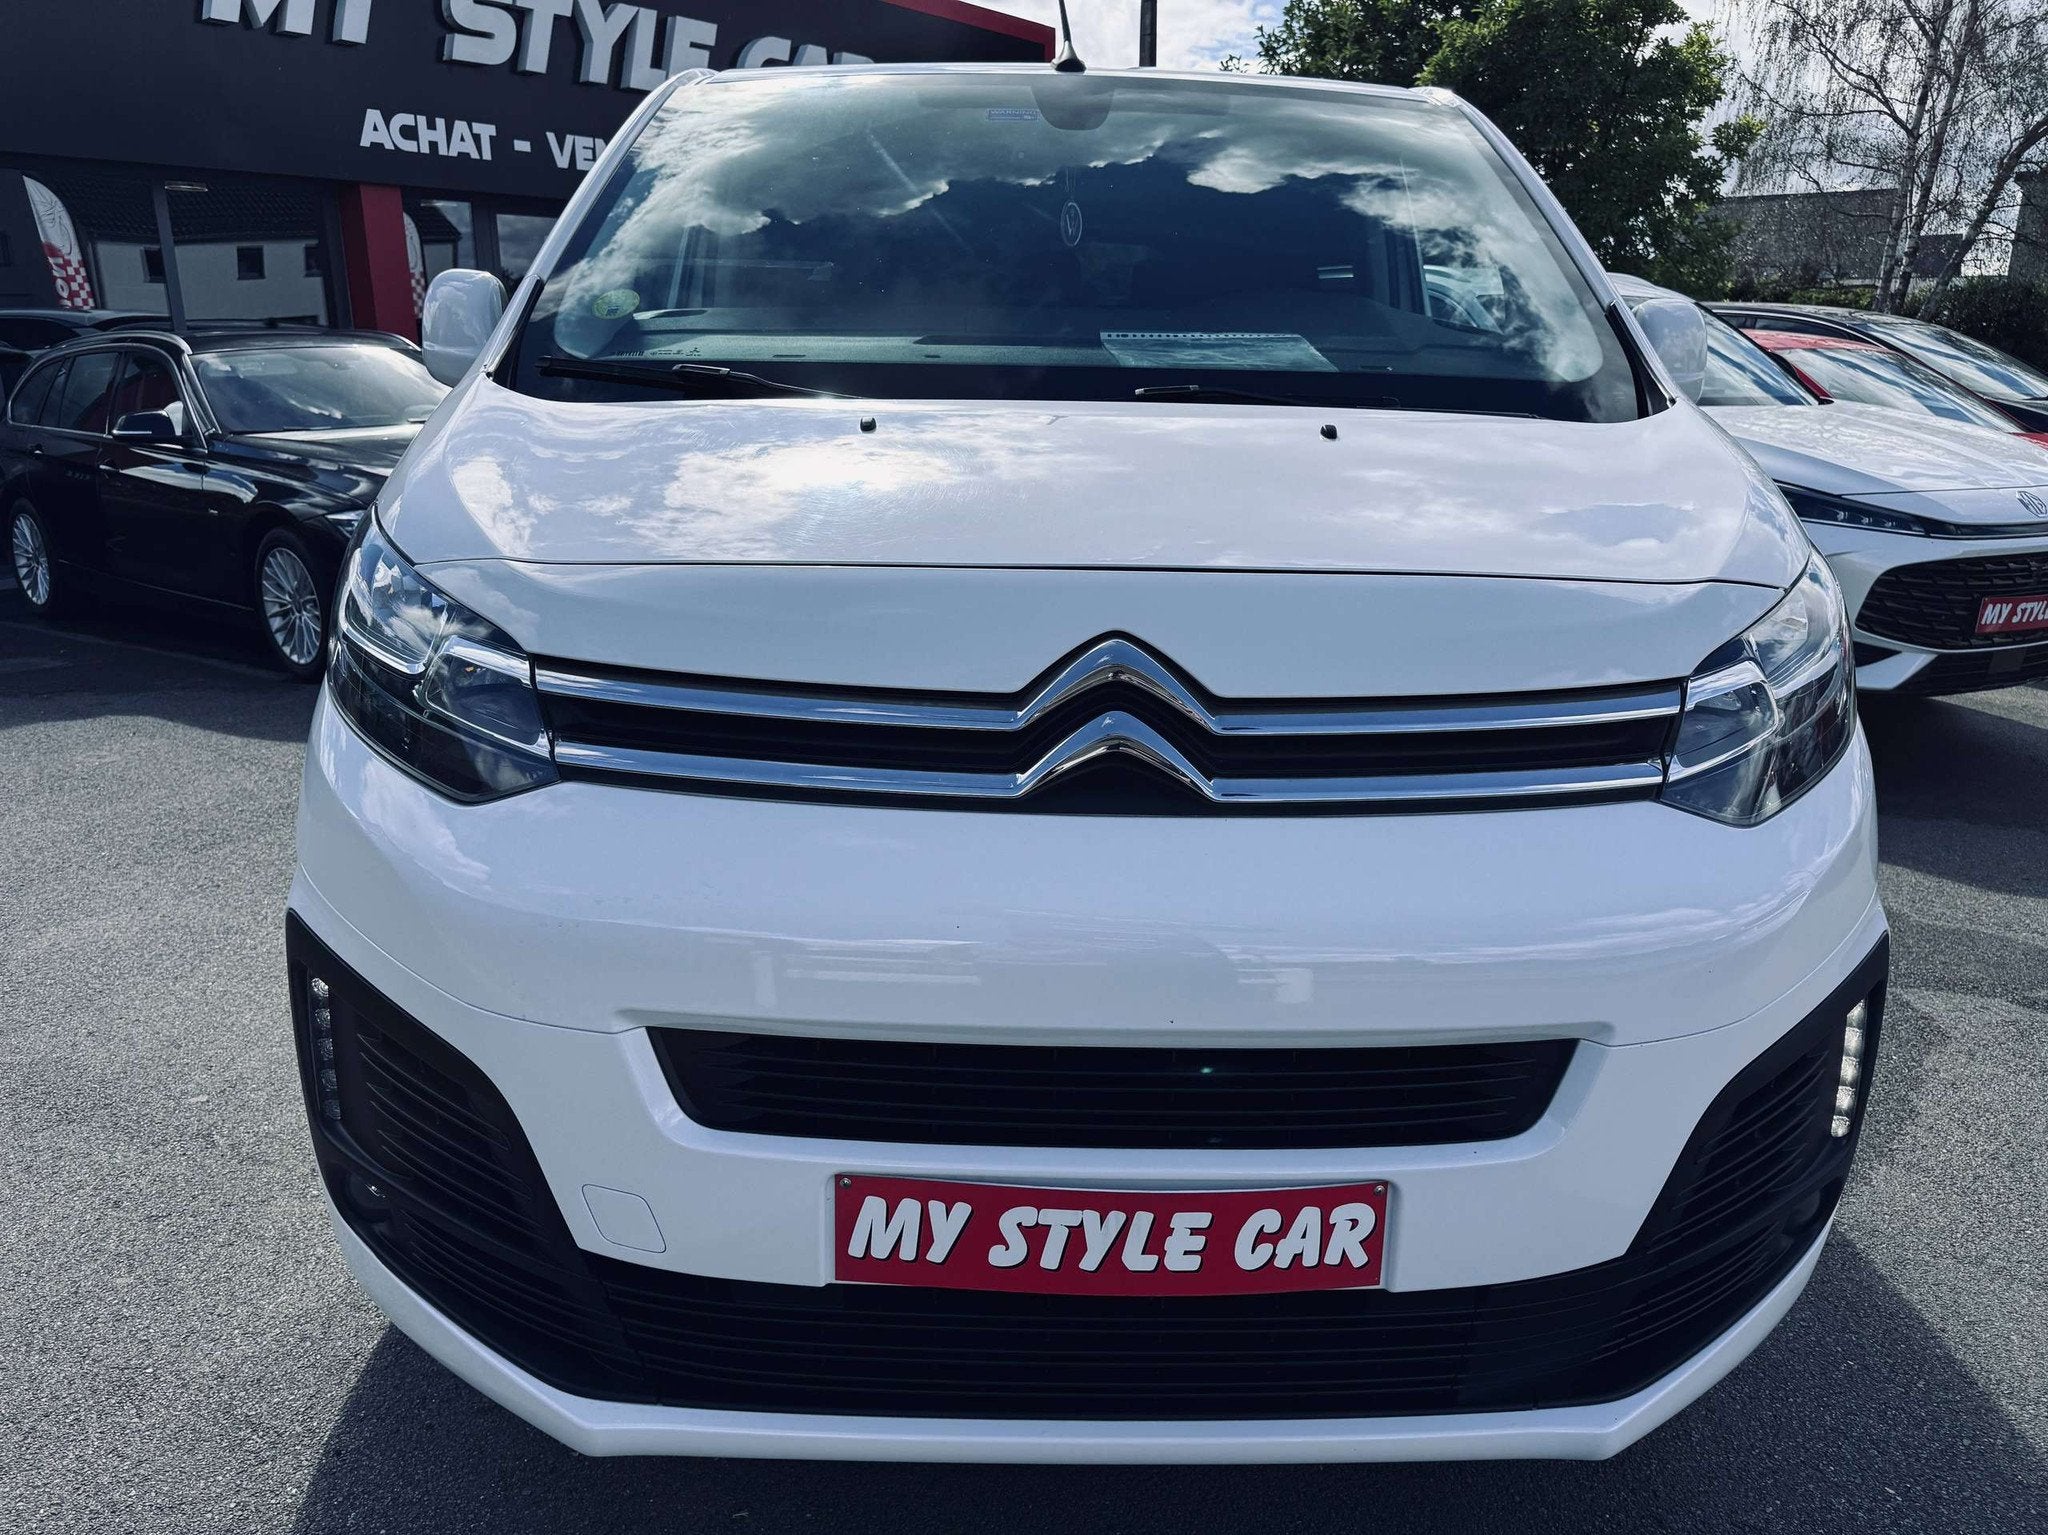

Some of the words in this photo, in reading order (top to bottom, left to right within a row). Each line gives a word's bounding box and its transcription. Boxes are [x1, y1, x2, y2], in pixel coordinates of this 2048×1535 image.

[443, 0, 719, 91] STYLE
[360, 108, 497, 161] ACHAT
[1981, 603, 2013, 625] MY
[848, 1195, 973, 1264] MY
[988, 1206, 1214, 1272] STYLE
[1233, 1202, 1378, 1270] CAR
